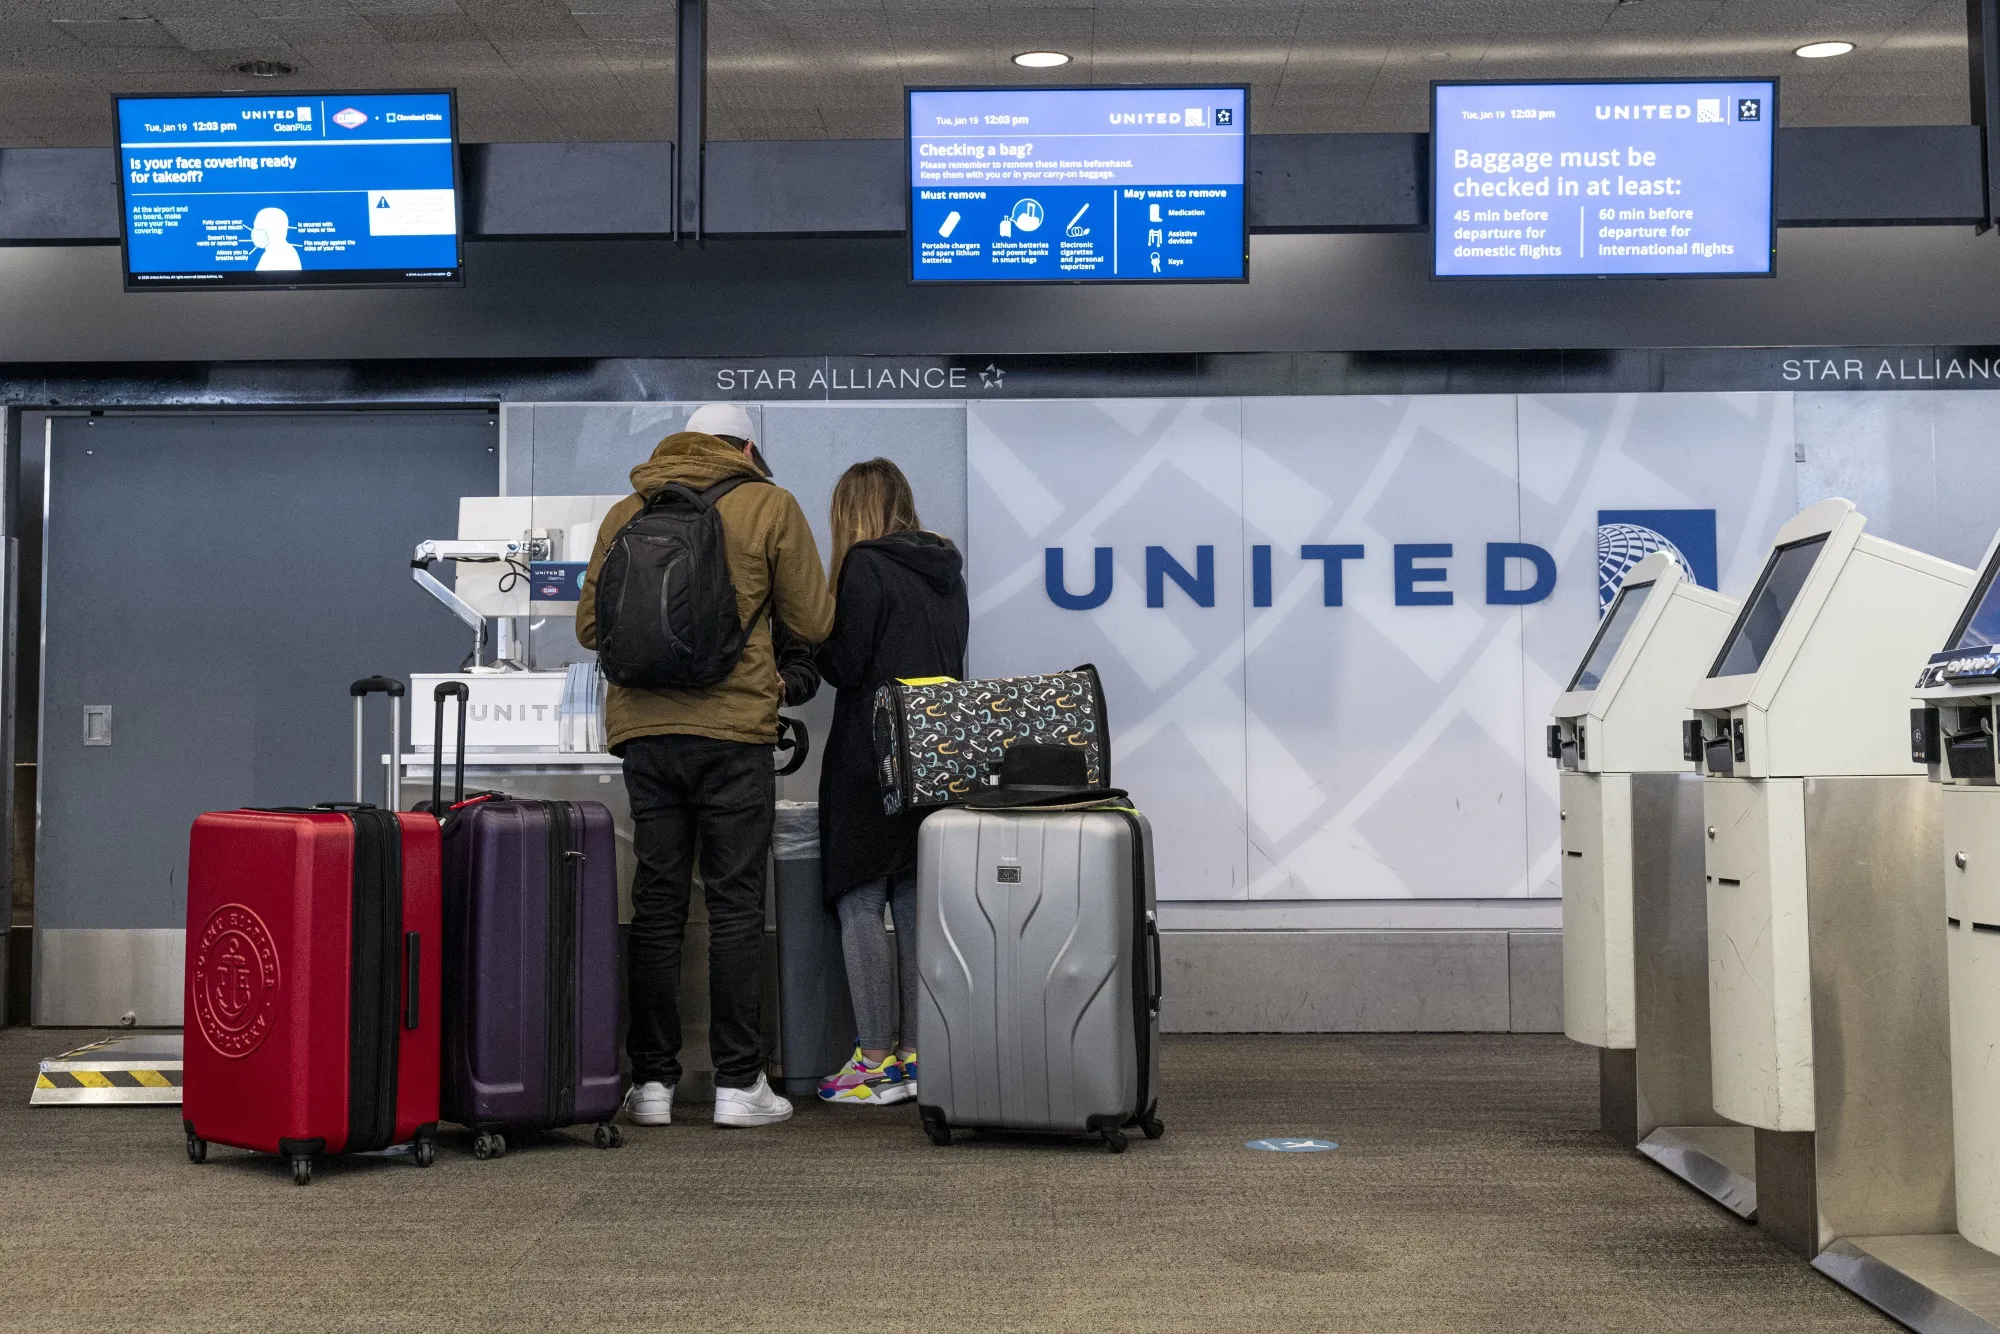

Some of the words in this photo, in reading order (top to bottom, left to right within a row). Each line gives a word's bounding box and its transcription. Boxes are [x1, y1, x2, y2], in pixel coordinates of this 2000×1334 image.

[242, 110, 294, 119] UNITED
[1110, 113, 1181, 124] UNITED
[1462, 111, 1479, 120] Tue,
[1480, 111, 1493, 120] Jan
[1511, 109, 1537, 118] 12:03
[1539, 111, 1555, 120] pm
[1596, 105, 1691, 120] UNITED
[936, 117, 953, 126] Tue,
[954, 117, 968, 126] Jan
[969, 116, 979, 124] 19
[984, 115, 1010, 124] 12:03
[1012, 116, 1029, 126] pm
[145, 124, 161, 132] Tue,
[163, 124, 175, 133] Jan
[178, 123, 187, 131] 19
[193, 122, 218, 131] 12:03
[220, 123, 237, 133] pm
[274, 123, 312, 132] CleanPlus
[920, 143, 984, 158] Checking
[988, 146, 996, 156] a
[1000, 143, 1033, 158] bag?
[131, 158, 141, 173] Is
[144, 159, 173, 173] your
[176, 156, 202, 172] face
[204, 156, 258, 170] covering
[261, 155, 296, 169] ready
[921, 161, 946, 169] Please
[949, 161, 991, 169] remember
[1035, 160, 1058, 168] these
[1060, 160, 1082, 168] items
[1084, 159, 1133, 168] beforehand.
[1455, 149, 1552, 173] Baggage
[1561, 149, 1620, 167] must
[1628, 146, 1656, 166] be
[131, 171, 150, 183] for
[152, 170, 203, 183] takeoff?
[921, 171, 941, 180] Keep
[943, 171, 964, 179] them
[966, 170, 984, 178] with
[985, 172, 1000, 180] you
[1013, 170, 1021, 178] in
[1023, 171, 1042, 180] your
[1043, 171, 1077, 180] carry-on
[1079, 170, 1115, 180] baggage.
[1454, 176, 1549, 197] checked
[1558, 176, 1578, 196] in
[1587, 178, 1610, 196] at
[1619, 175, 1681, 195] least:
[921, 191, 946, 199] Must
[1124, 189, 1145, 200] May
[1148, 189, 1173, 198] want
[1176, 189, 1186, 197] to
[1189, 190, 1226, 198] remove
[1455, 210, 1470, 221] 45
[1475, 210, 1500, 221] min
[1504, 208, 1548, 221] before
[1599, 208, 1615, 220] 60
[1619, 208, 1644, 220] min
[1649, 207, 1693, 220] before
[1455, 227, 1522, 242] departure
[1526, 227, 1546, 238] for
[1599, 226, 1667, 240] departure
[1671, 225, 1691, 237] for
[922, 242, 950, 251] Portable
[952, 242, 980, 250] chargers
[1454, 245, 1516, 257] domestic
[1520, 244, 1561, 259] flights
[1599, 243, 1687, 256] international
[1691, 242, 1734, 257] flights
[1022, 256, 1037, 264] bags
[1075, 256, 1103, 264] personal
[1169, 258, 1183, 266] Keys
[1061, 263, 1095, 271] vaporizers
[1782, 359, 1863, 381] STAR
[716, 369, 796, 390] STAR
[808, 367, 966, 389] ALLIANCE
[1045, 542, 1558, 611] UNITED
